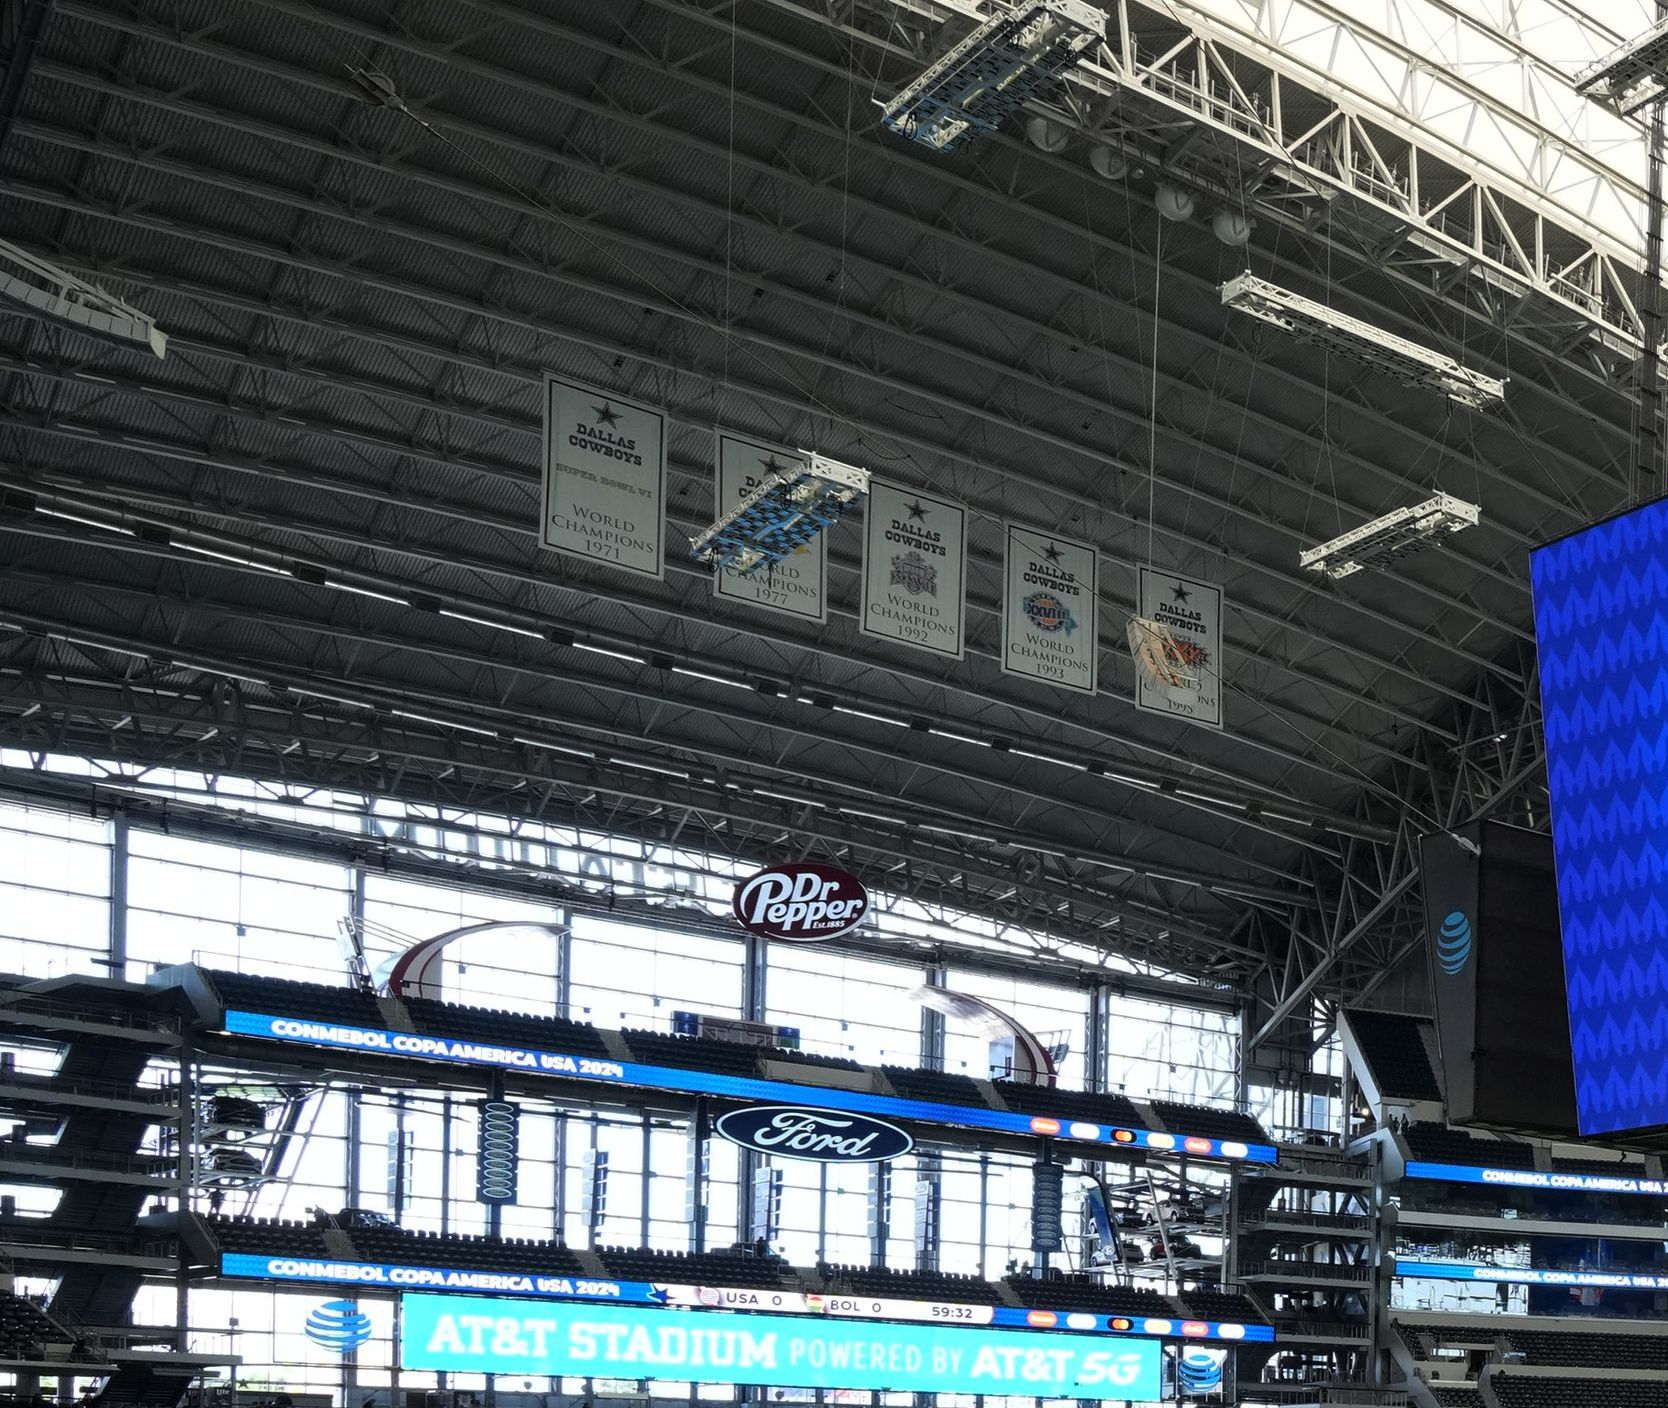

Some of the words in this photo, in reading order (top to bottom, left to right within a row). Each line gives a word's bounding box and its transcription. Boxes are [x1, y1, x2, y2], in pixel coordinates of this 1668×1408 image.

[577, 423, 636, 451] DALLAS
[569, 435, 642, 466] COWBOYS
[572, 503, 635, 532] WORLD
[892, 519, 941, 542] DALLAS
[552, 514, 653, 553] CHAMPIONS
[885, 530, 946, 556] COWBOYS
[585, 540, 620, 559] 1971
[1023, 572, 1080, 596] COWBOYS
[1029, 562, 1075, 583] DALLAS
[755, 587, 788, 605] 1977
[888, 593, 939, 617] WORLD
[871, 603, 955, 635] CHAMPIONS
[1154, 612, 1207, 634] COWBOYS
[1159, 602, 1202, 621] DALLAS
[899, 625, 928, 642] 1992
[1026, 633, 1074, 655] WORLD
[1011, 643, 1088, 672] CHAMPIONS
[1037, 663, 1064, 679] 1993
[789, 873, 840, 902] Dr
[740, 872, 863, 931] Pepper
[754, 1112, 880, 1156] Ford
[726, 1292, 759, 1305] USA
[830, 1299, 861, 1312] BOL
[931, 1306, 973, 1319] 59:32
[426, 1313, 557, 1358] AT&T
[568, 1321, 779, 1368] STADIUM
[789, 1337, 922, 1373] POWERED
[933, 1346, 963, 1375] BY
[969, 1345, 1075, 1382] AT&T
[1076, 1352, 1143, 1386] 5G
